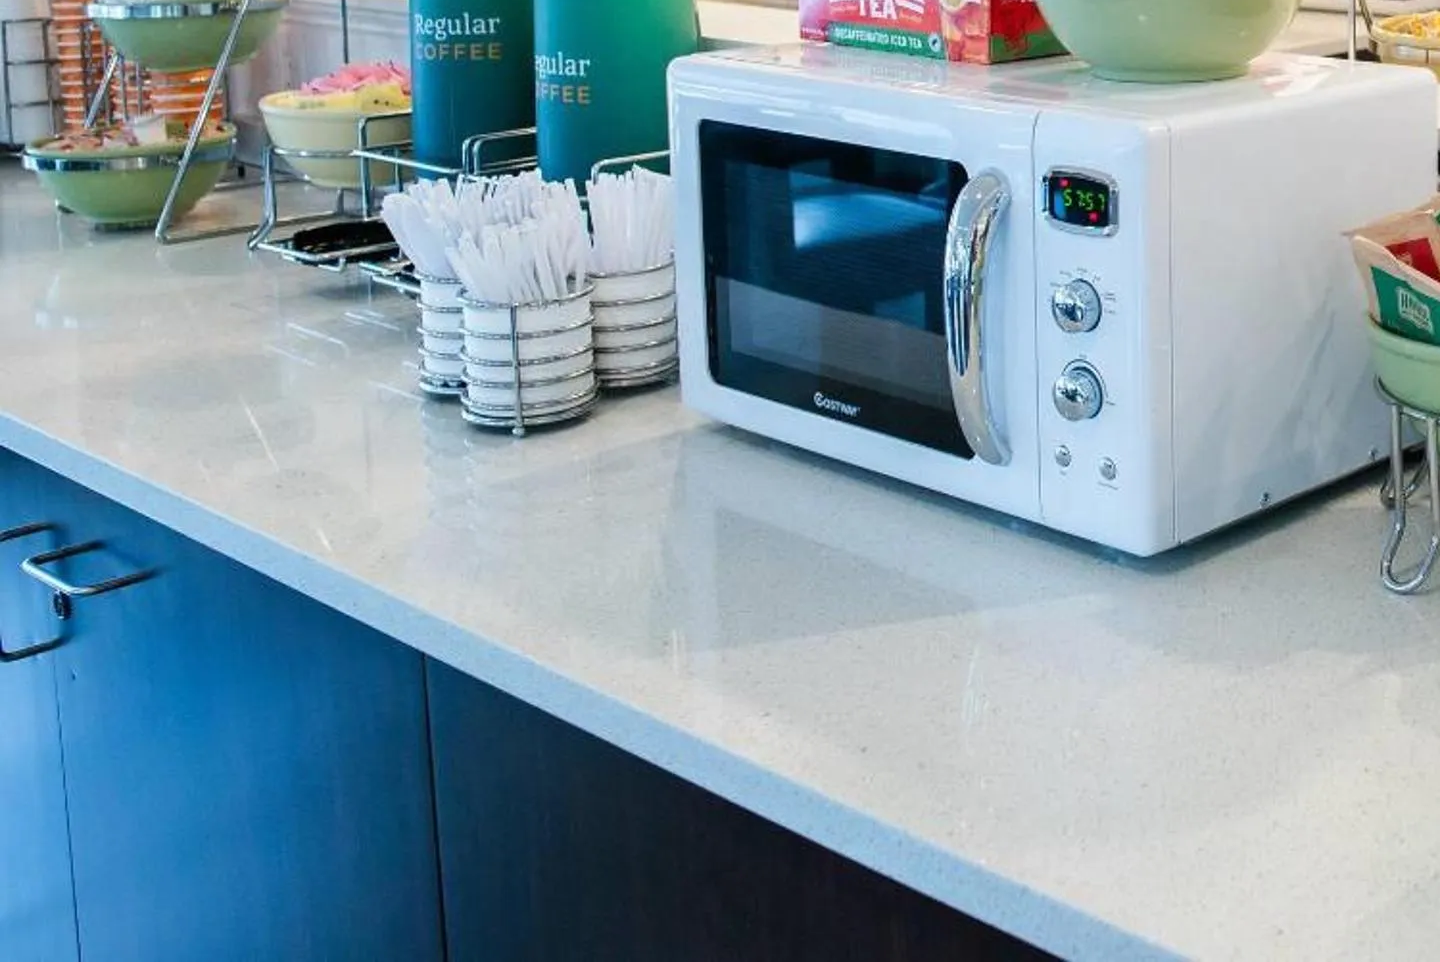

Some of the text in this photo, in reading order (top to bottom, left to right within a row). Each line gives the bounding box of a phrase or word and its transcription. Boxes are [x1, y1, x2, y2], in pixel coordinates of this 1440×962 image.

[414, 12, 500, 41] Regular
[415, 42, 503, 61] COFFEE
[535, 51, 591, 79] egular
[535, 82, 592, 105] FFEE
